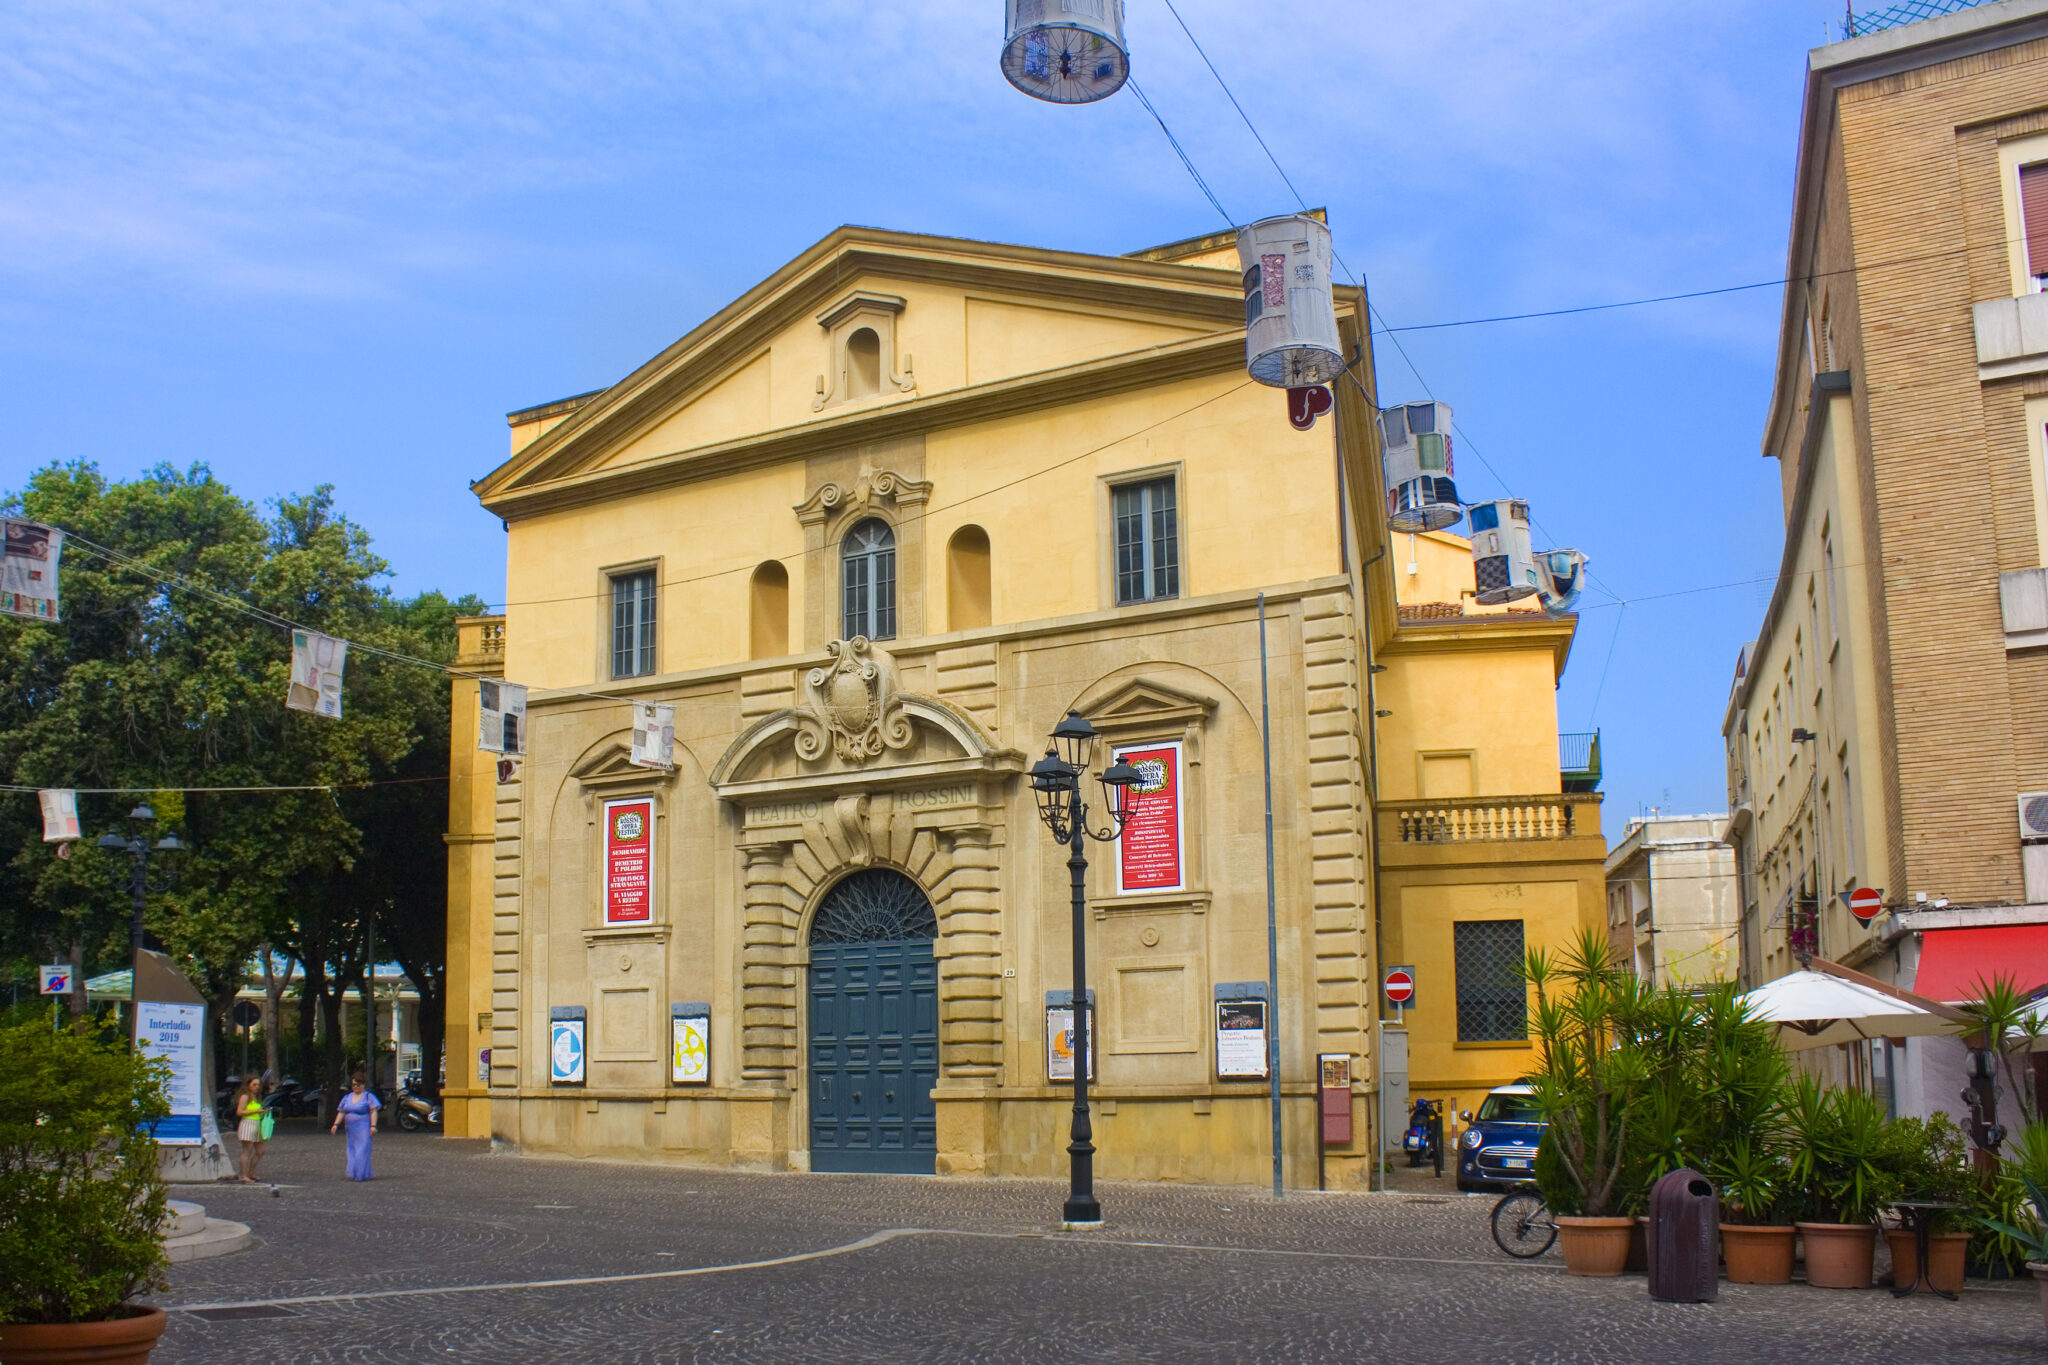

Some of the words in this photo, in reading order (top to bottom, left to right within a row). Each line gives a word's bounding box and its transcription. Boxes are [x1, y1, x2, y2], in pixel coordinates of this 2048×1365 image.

[747, 801, 819, 823] TEATRO
[899, 784, 973, 809] ROSSINI
[149, 1018, 191, 1031] Interludio
[160, 1031, 180, 1043] 2019
